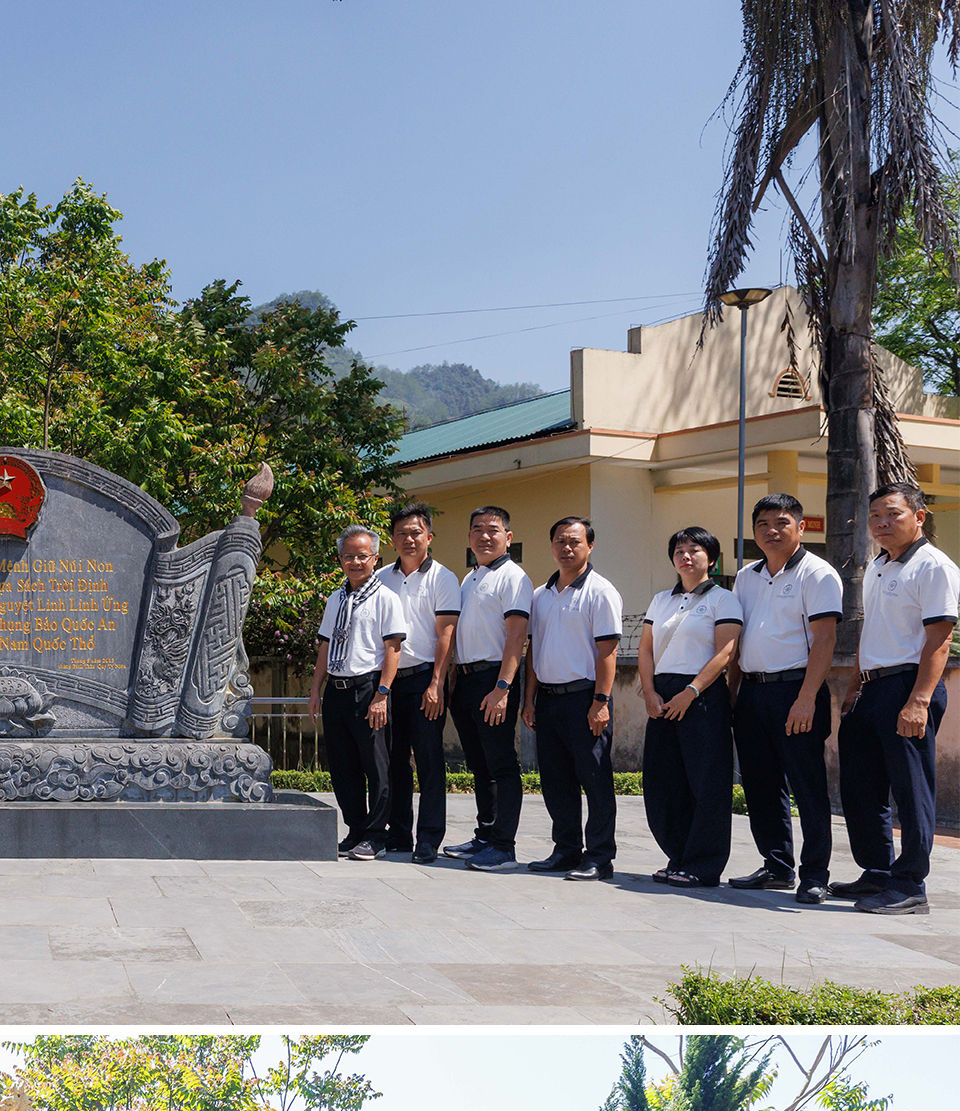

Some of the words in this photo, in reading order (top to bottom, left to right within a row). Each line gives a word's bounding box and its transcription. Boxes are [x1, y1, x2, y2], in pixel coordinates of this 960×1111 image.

[33, 560, 56, 572] Giữ
[60, 559, 82, 572] Núi
[87, 559, 114, 572] Non
[17, 578, 45, 592] Sách
[49, 578, 74, 592] Trời
[78, 578, 108, 594] Định
[37, 598, 66, 611] Linh
[70, 598, 99, 611] Linh
[102, 595, 128, 614] Ứng
[61, 617, 95, 633] Quốc
[97, 618, 116, 630] An
[0, 636, 30, 650] Nam
[33, 636, 66, 653] Quốc
